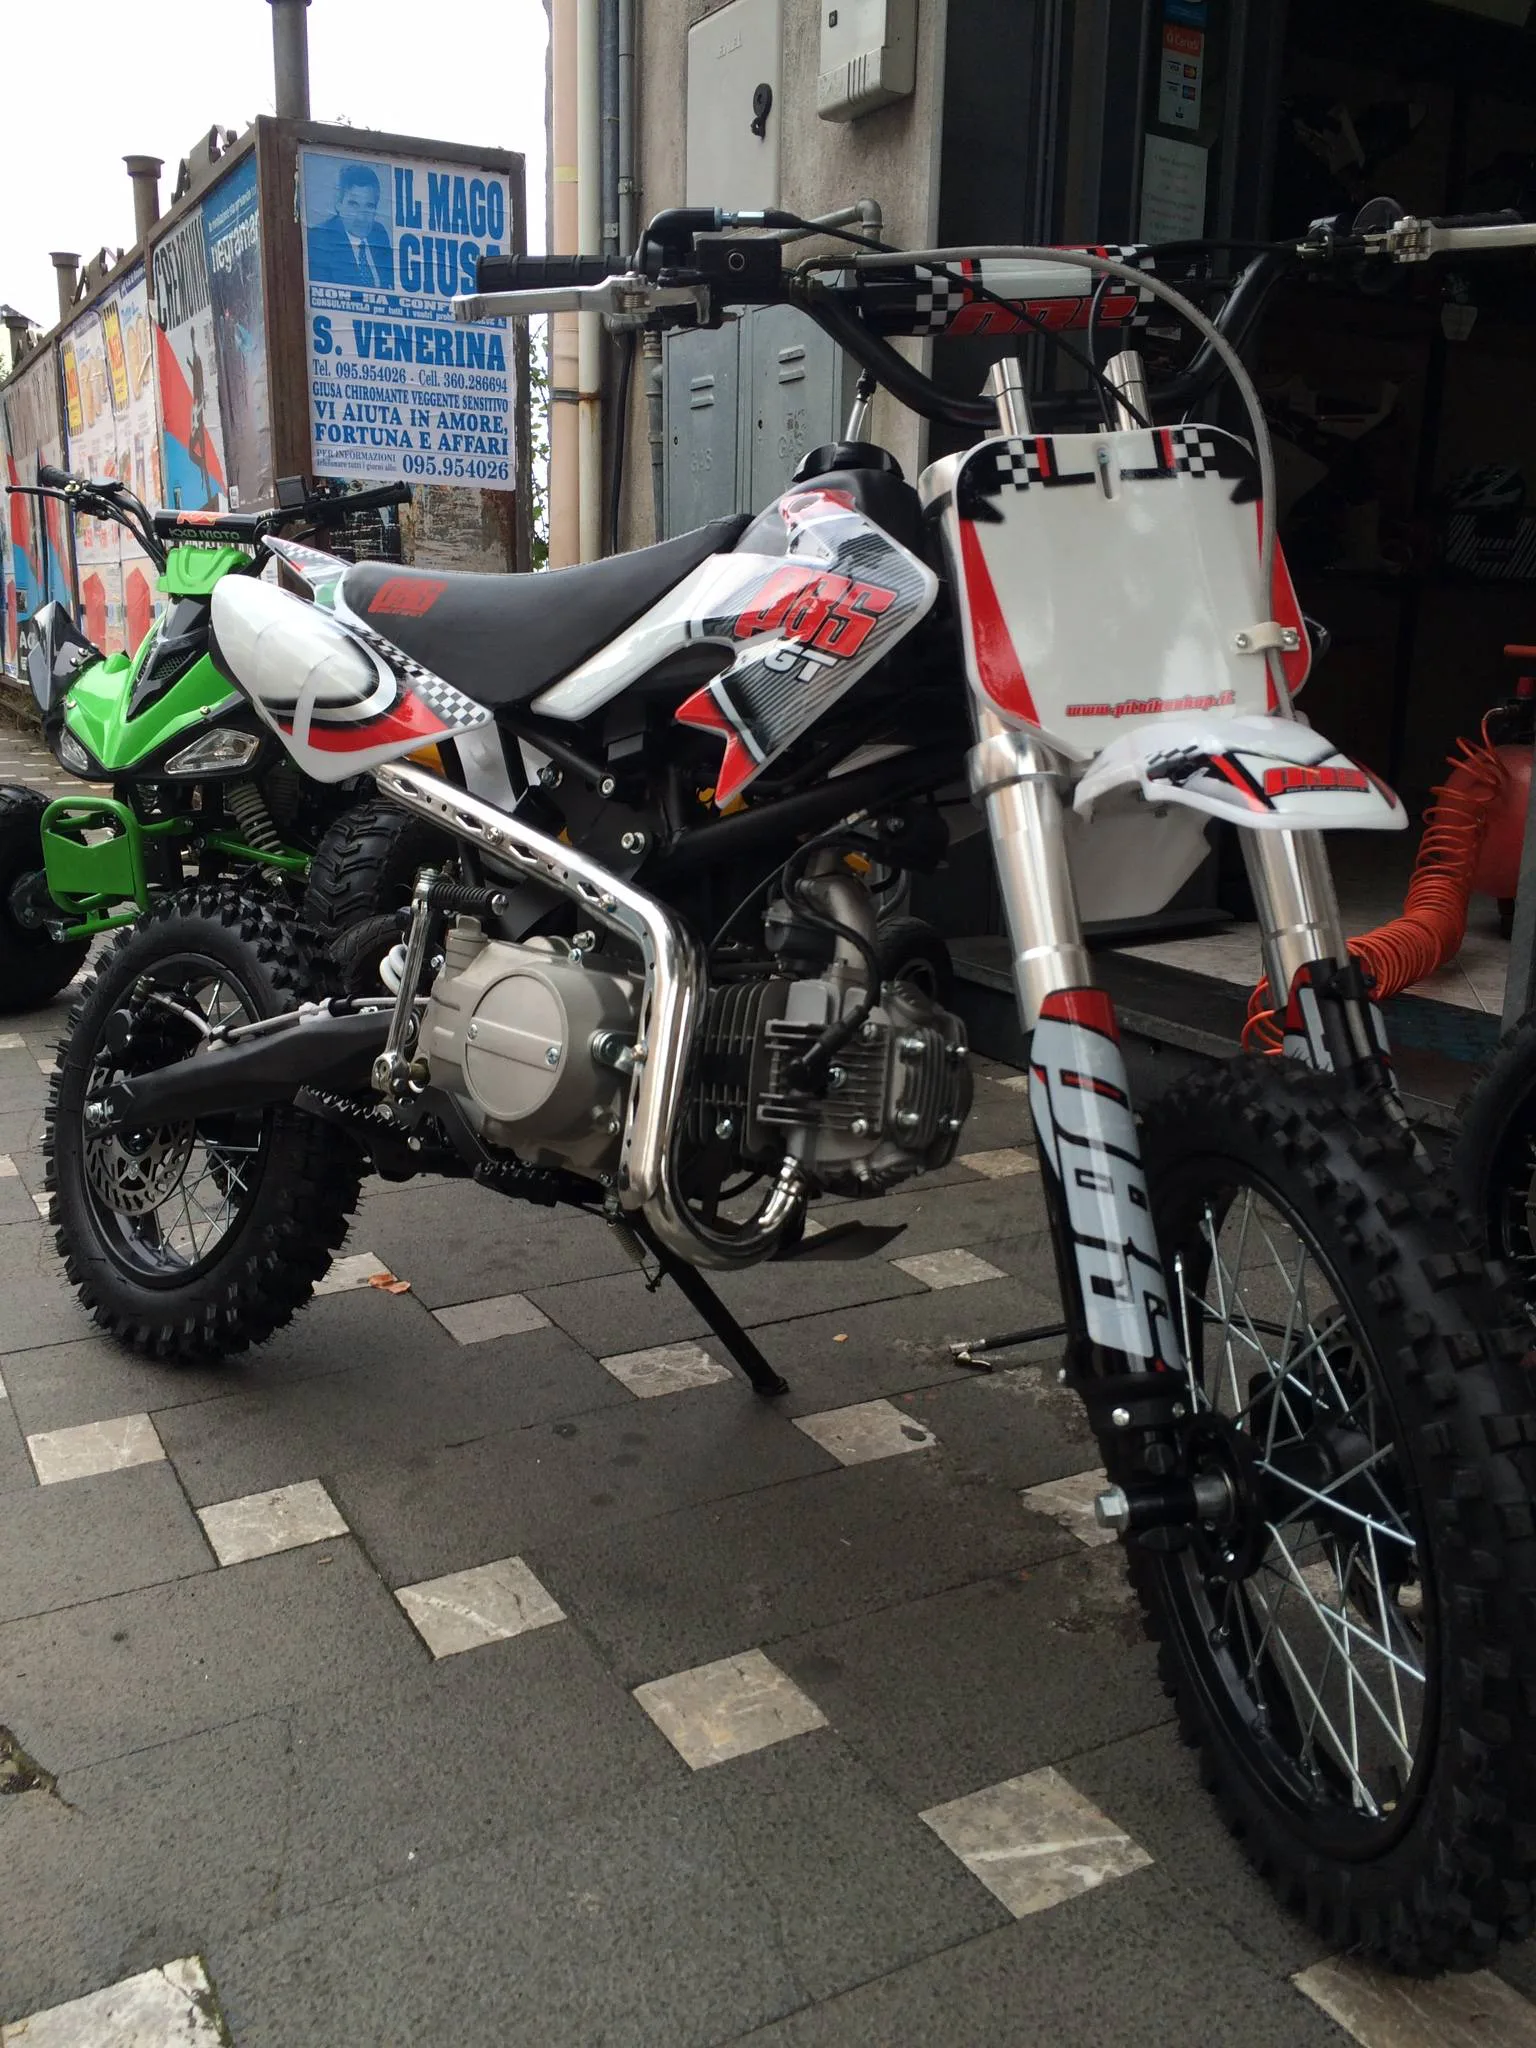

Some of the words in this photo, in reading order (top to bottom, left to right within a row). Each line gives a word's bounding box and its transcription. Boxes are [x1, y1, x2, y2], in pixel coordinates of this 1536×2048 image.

[394, 167, 423, 230] IL
[427, 171, 504, 241] MAGO
[210, 207, 260, 274] negramar
[399, 232, 501, 299] GIUS
[311, 286, 352, 301] NON
[362, 292, 389, 305] HA
[311, 297, 371, 313] CONSULTATELO
[312, 315, 343, 356] S.
[352, 319, 507, 372] VENERINA
[312, 358, 331, 377] Tel.
[335, 363, 407, 384] 095.954026
[418, 369, 441, 387] Cell.
[443, 372, 508, 393] 360.286694
[312, 381, 343, 399] GIUSA
[344, 383, 409, 405] CHIROMANTE
[411, 389, 461, 409] VEGGENTE
[462, 395, 509, 413] SENSITIVO
[314, 400, 336, 420] VI
[342, 402, 403, 425] AIUTA
[410, 408, 430, 429] IN
[436, 413, 509, 435] AMORE,
[315, 423, 414, 449] FORTUNA
[419, 431, 432, 450] E
[438, 433, 509, 456] AFFARI
[316, 448, 334, 458] PER
[335, 449, 396, 463] INFORMAZIONI
[402, 454, 509, 481] 095.954026
[169, 527, 198, 538] KXD
[198, 529, 241, 540] MOTO
[763, 641, 840, 684] GT
